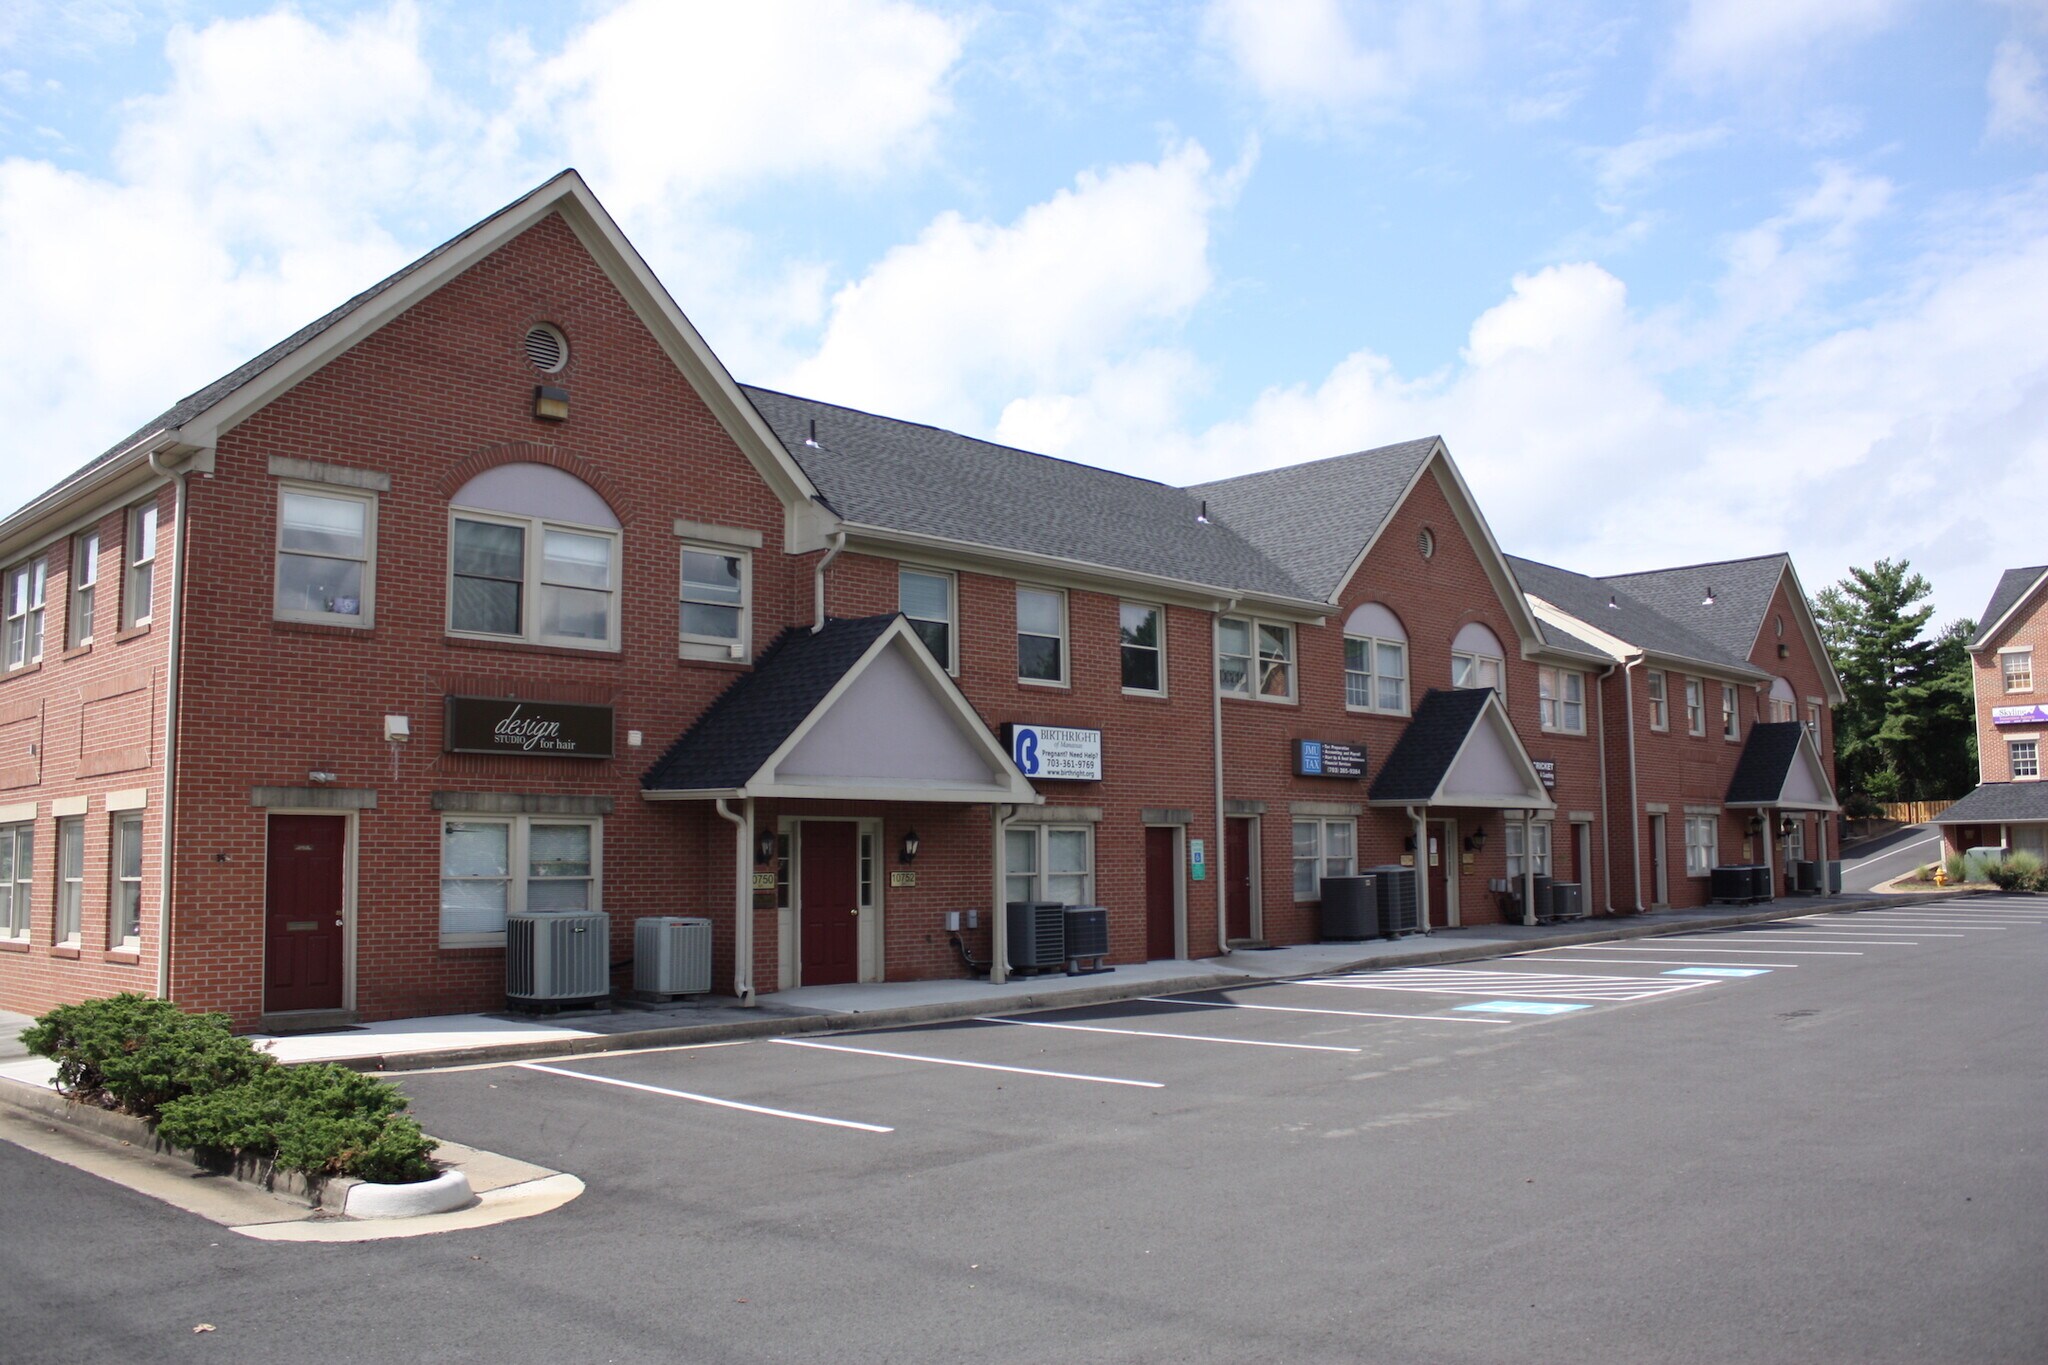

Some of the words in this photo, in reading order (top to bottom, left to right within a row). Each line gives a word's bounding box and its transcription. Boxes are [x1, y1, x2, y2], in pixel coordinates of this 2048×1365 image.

[494, 704, 560, 750] design
[494, 735, 526, 744] STUDIO
[1040, 729, 1099, 742] BIRTHRIGHT
[540, 738, 553, 749] for
[556, 739, 576, 750] hair
[1042, 750, 1068, 758] Pregnant?
[1305, 745, 1319, 756] JMU
[1047, 759, 1095, 769] 703-361-9769
[1305, 759, 1320, 769] TAX
[1047, 769, 1095, 778] www.birthright.org
[892, 873, 915, 883] 10752
